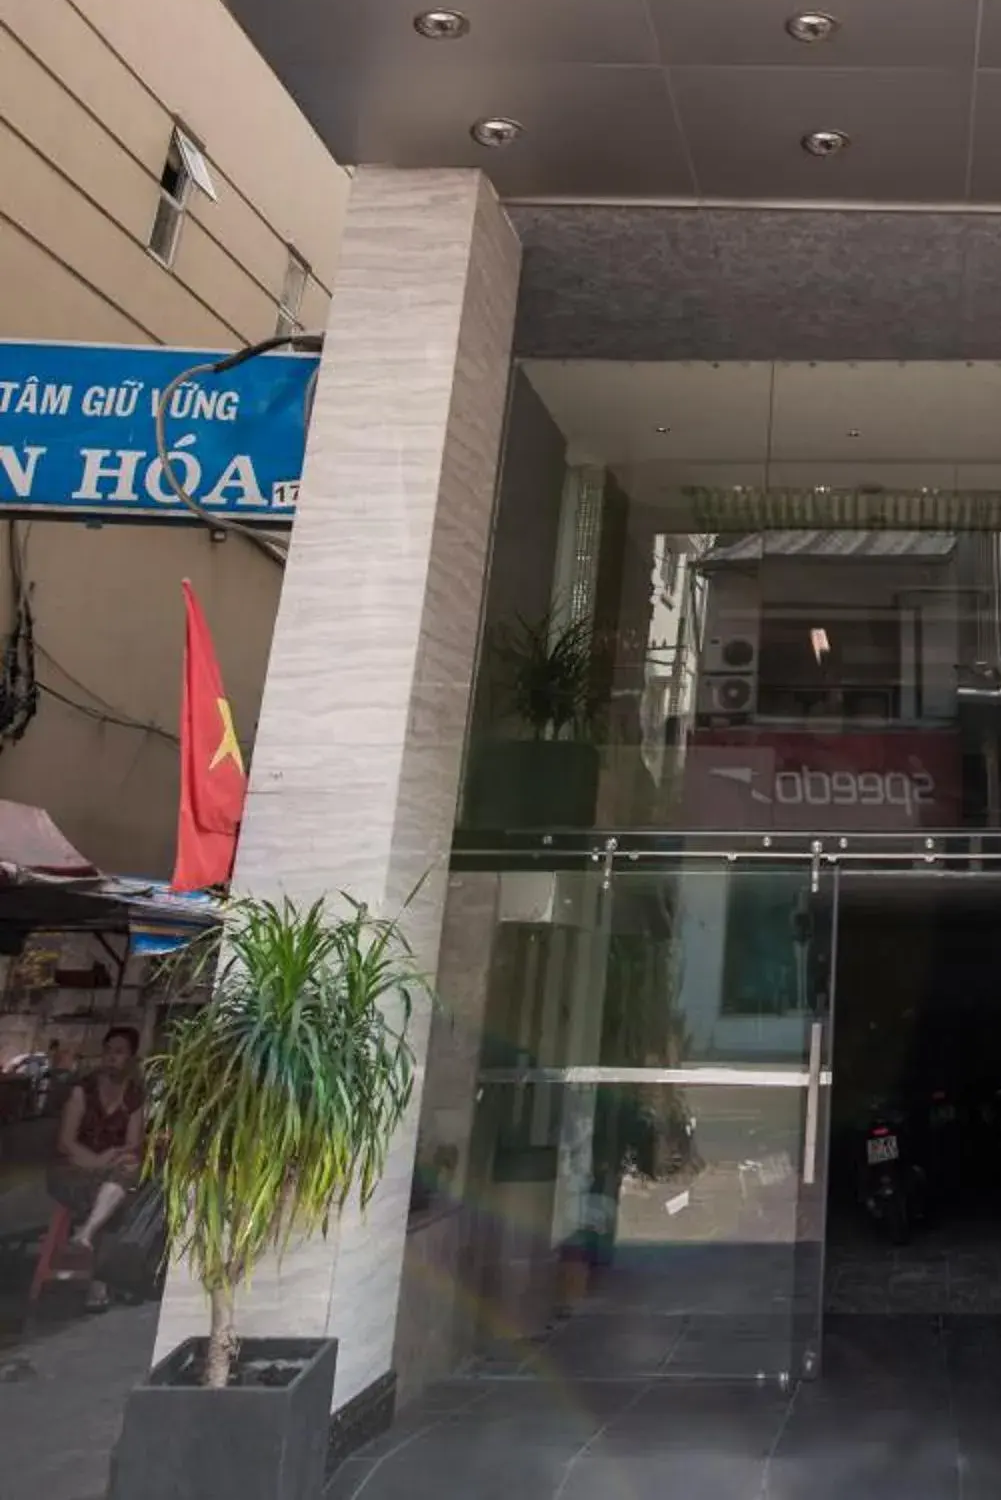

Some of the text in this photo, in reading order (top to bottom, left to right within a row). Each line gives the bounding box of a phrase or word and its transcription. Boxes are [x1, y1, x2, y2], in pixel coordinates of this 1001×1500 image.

[0, 375, 73, 416] TÂM
[81, 379, 145, 417] GIỮ
[71, 434, 268, 506] HÓA
